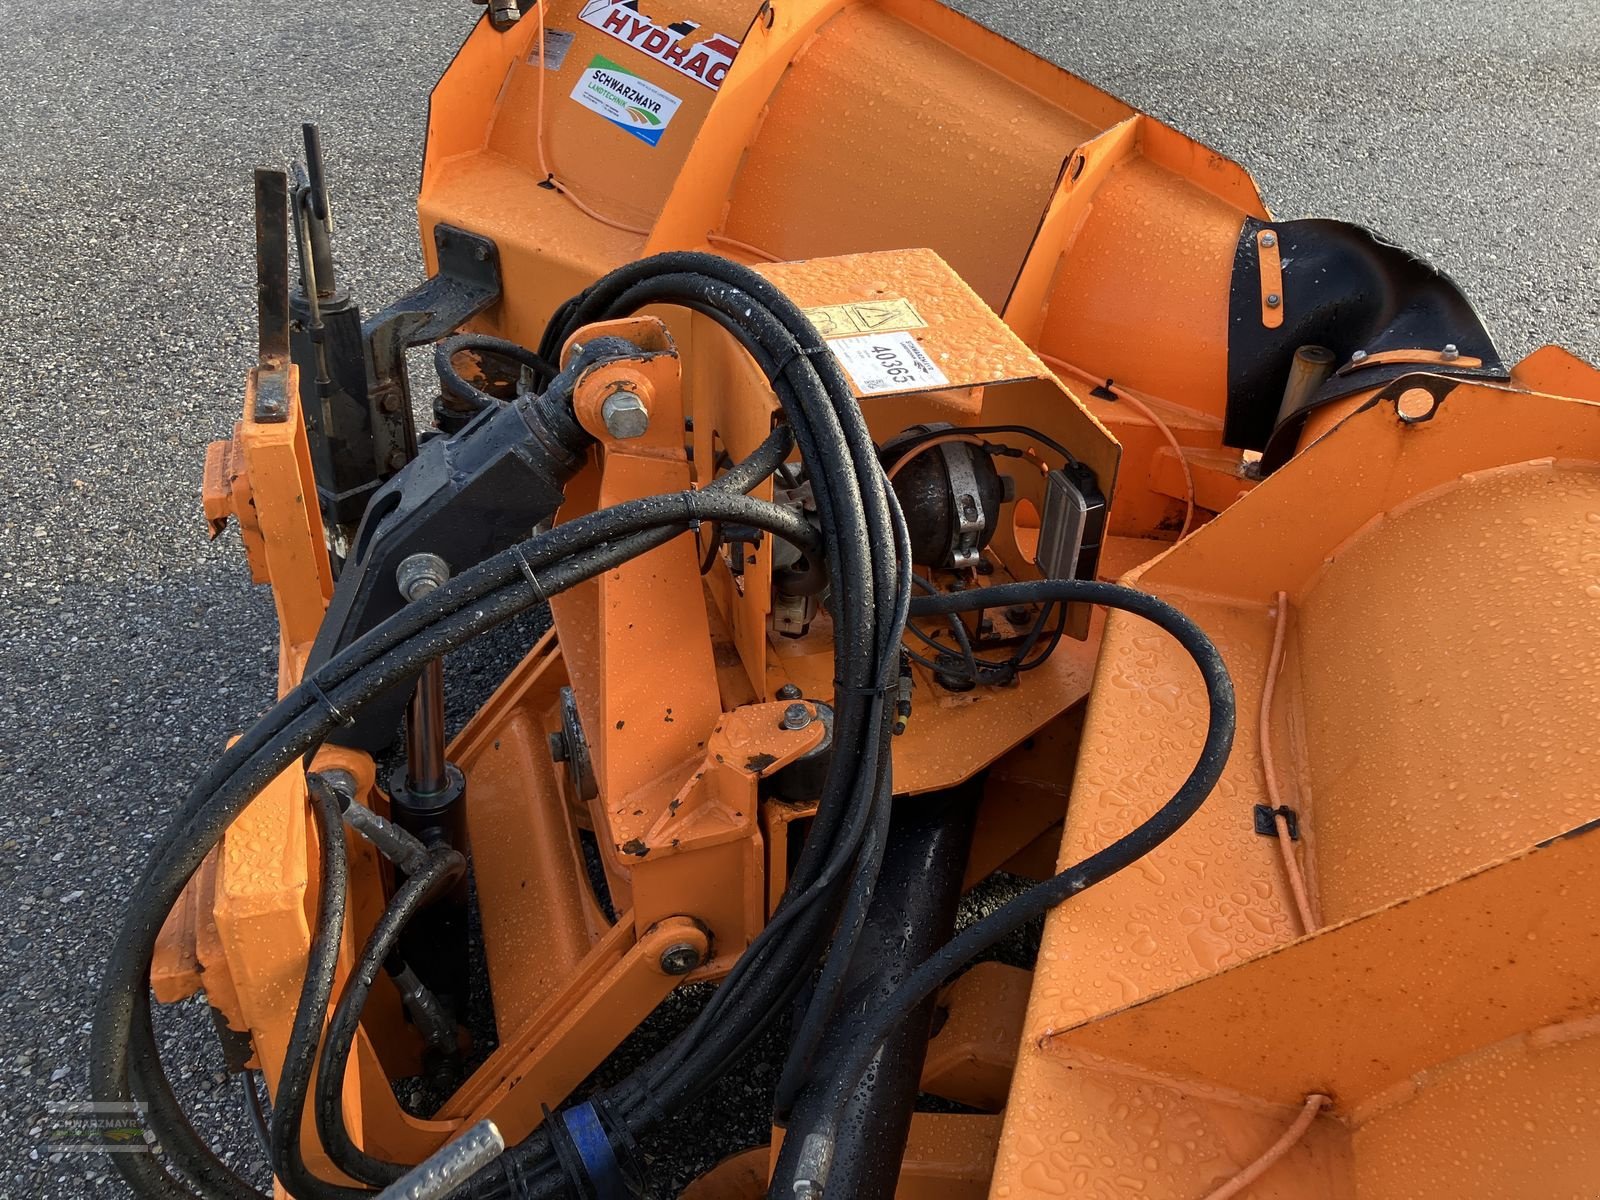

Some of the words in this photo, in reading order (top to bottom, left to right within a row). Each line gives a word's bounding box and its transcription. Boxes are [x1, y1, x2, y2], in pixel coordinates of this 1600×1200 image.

[587, 82, 628, 107] LANDTECHNIK
[592, 69, 662, 114] SCHWARZMAYR
[871, 346, 915, 384] 40365
